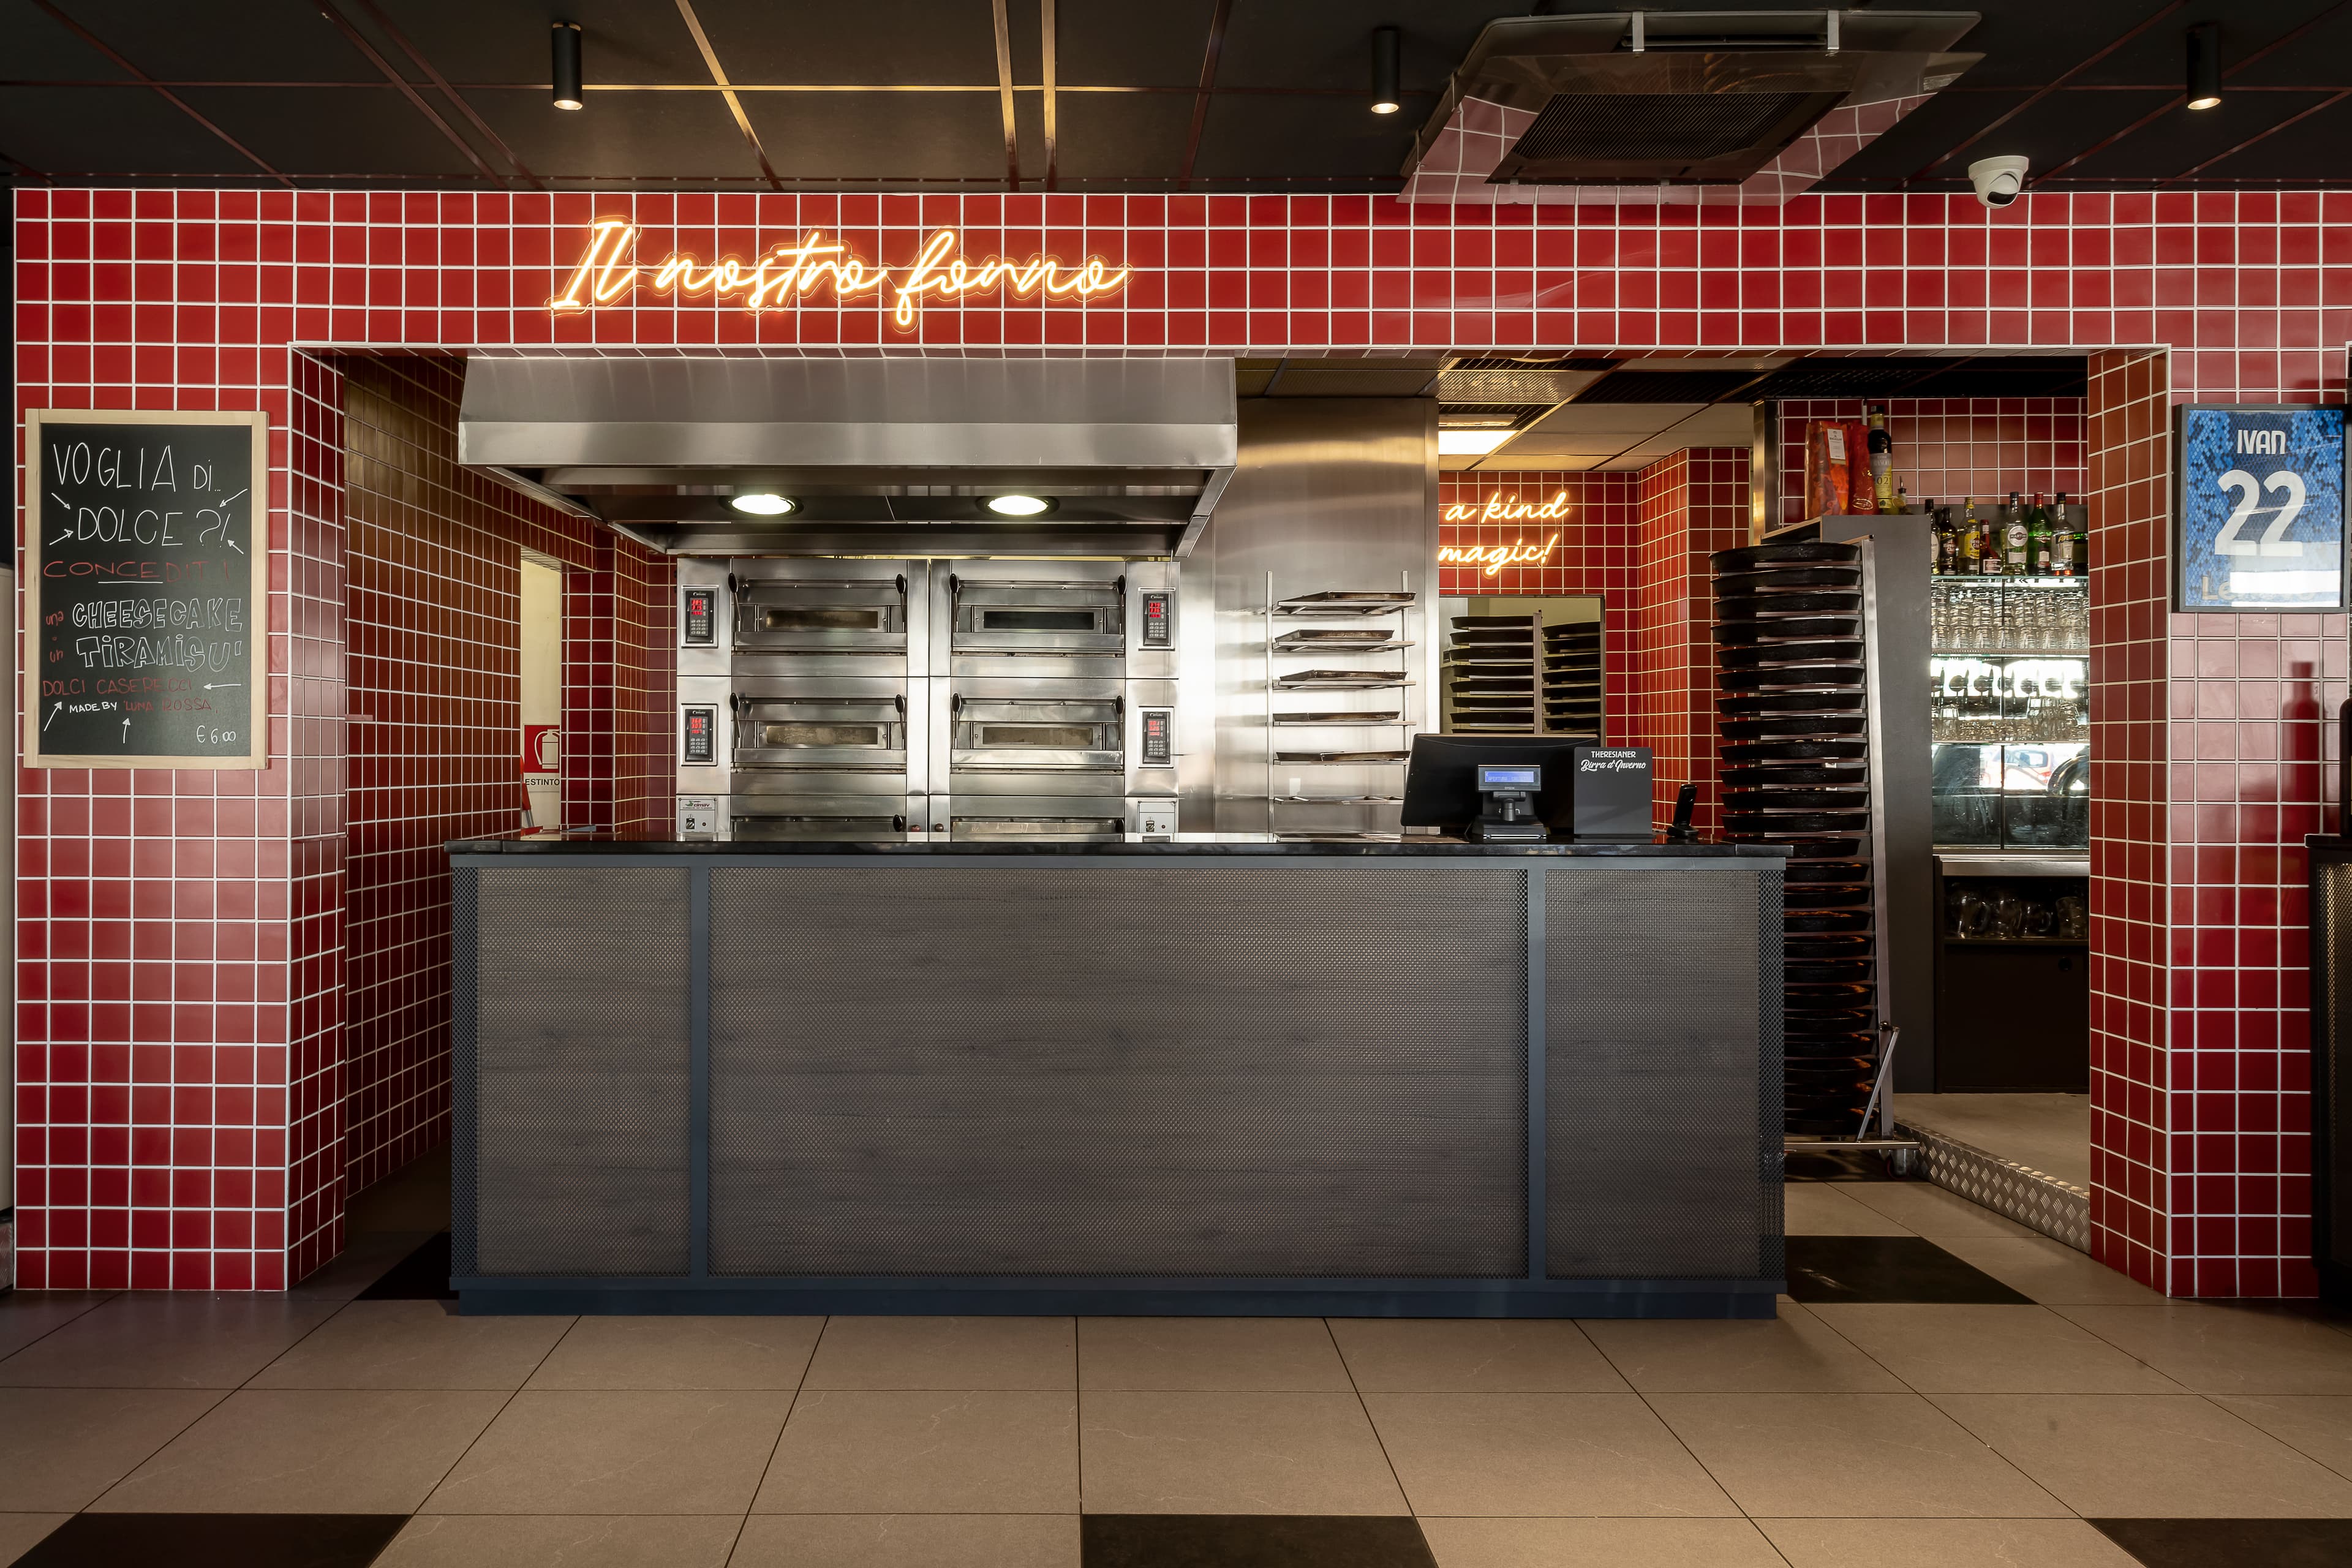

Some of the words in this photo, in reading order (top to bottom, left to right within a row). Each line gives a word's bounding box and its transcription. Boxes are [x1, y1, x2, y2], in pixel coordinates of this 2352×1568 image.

[551, 221, 638, 309] Il
[655, 231, 888, 307] nostro
[895, 230, 1129, 326] forno
[2237, 429, 2286, 454] IVAN
[53, 442, 176, 492] VOGLIA
[1445, 504, 1477, 521] a
[1480, 491, 1569, 524] kind
[2214, 469, 2307, 557] 22
[78, 507, 183, 546] DOLCE
[1438, 533, 1558, 576] magic!
[72, 598, 243, 632] CHEESECAKE
[50, 649, 64, 663] un
[42, 679, 86, 696] DOLCI
[97, 677, 192, 695] CASERECCI
[69, 704, 100, 714] MADE
[102, 701, 118, 712] BY
[1580, 759, 1606, 772] Birra
